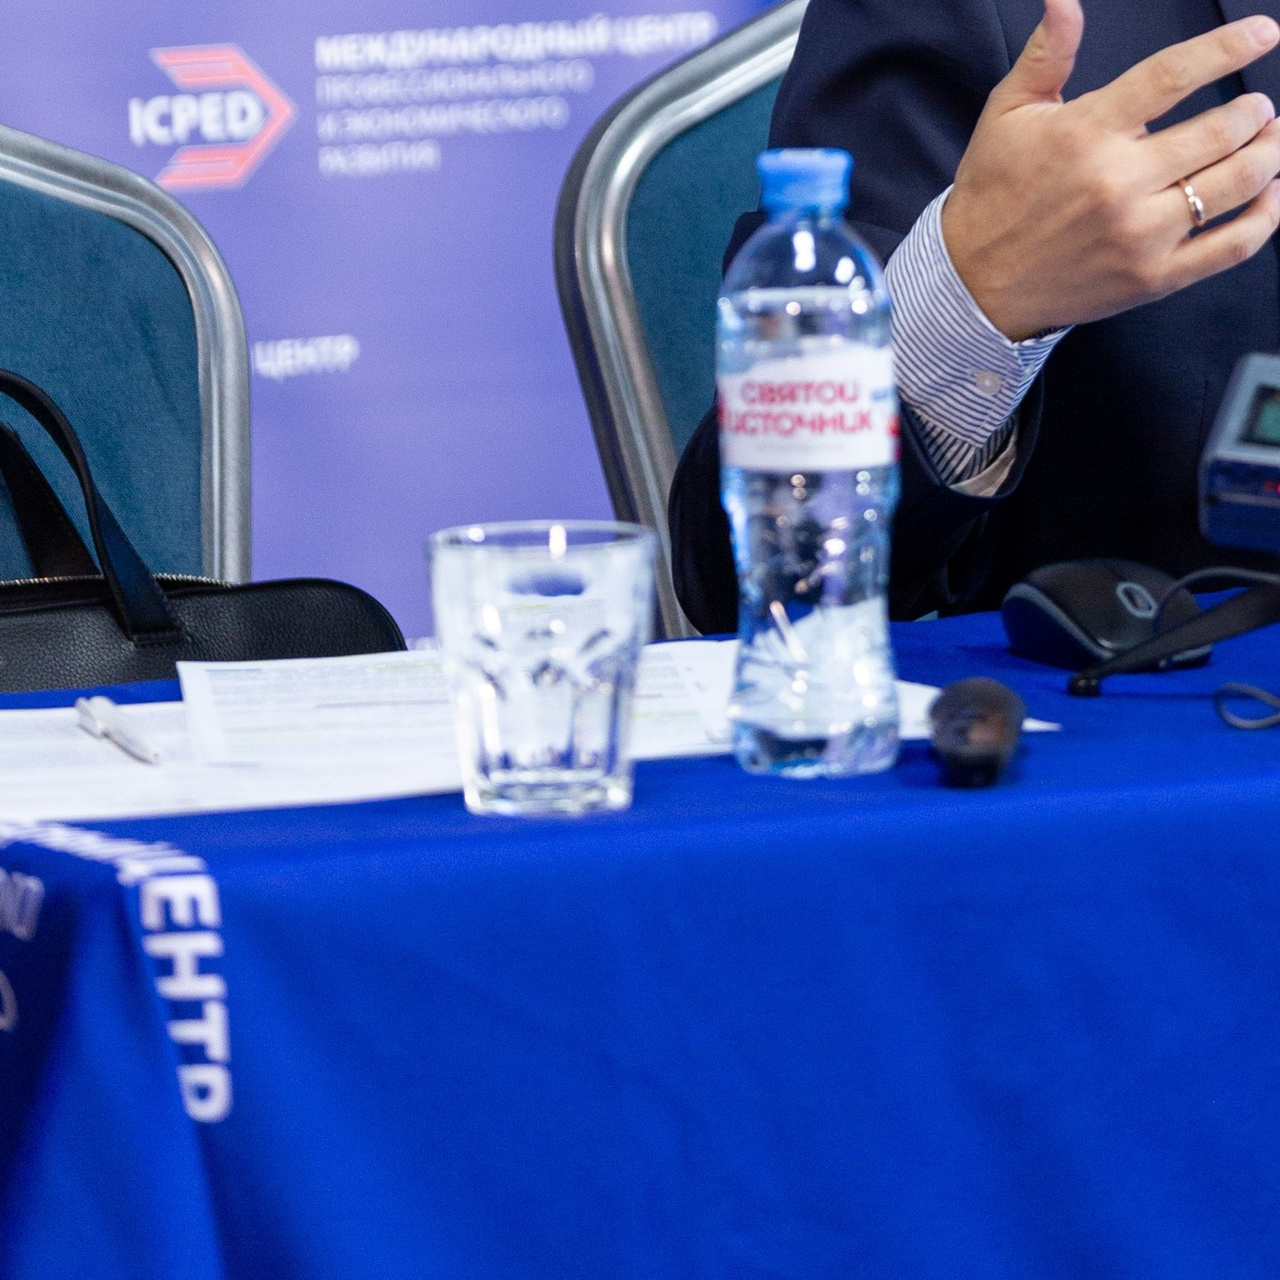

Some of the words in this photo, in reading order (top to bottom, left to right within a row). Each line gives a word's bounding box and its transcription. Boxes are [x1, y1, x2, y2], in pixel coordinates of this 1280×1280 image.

[315, 13, 609, 70] МЕЖДУНАРОДНЫЙ
[612, 12, 716, 55] ЦЕНТР
[129, 91, 266, 145] ICPED
[253, 334, 360, 381] ЦЕНТР
